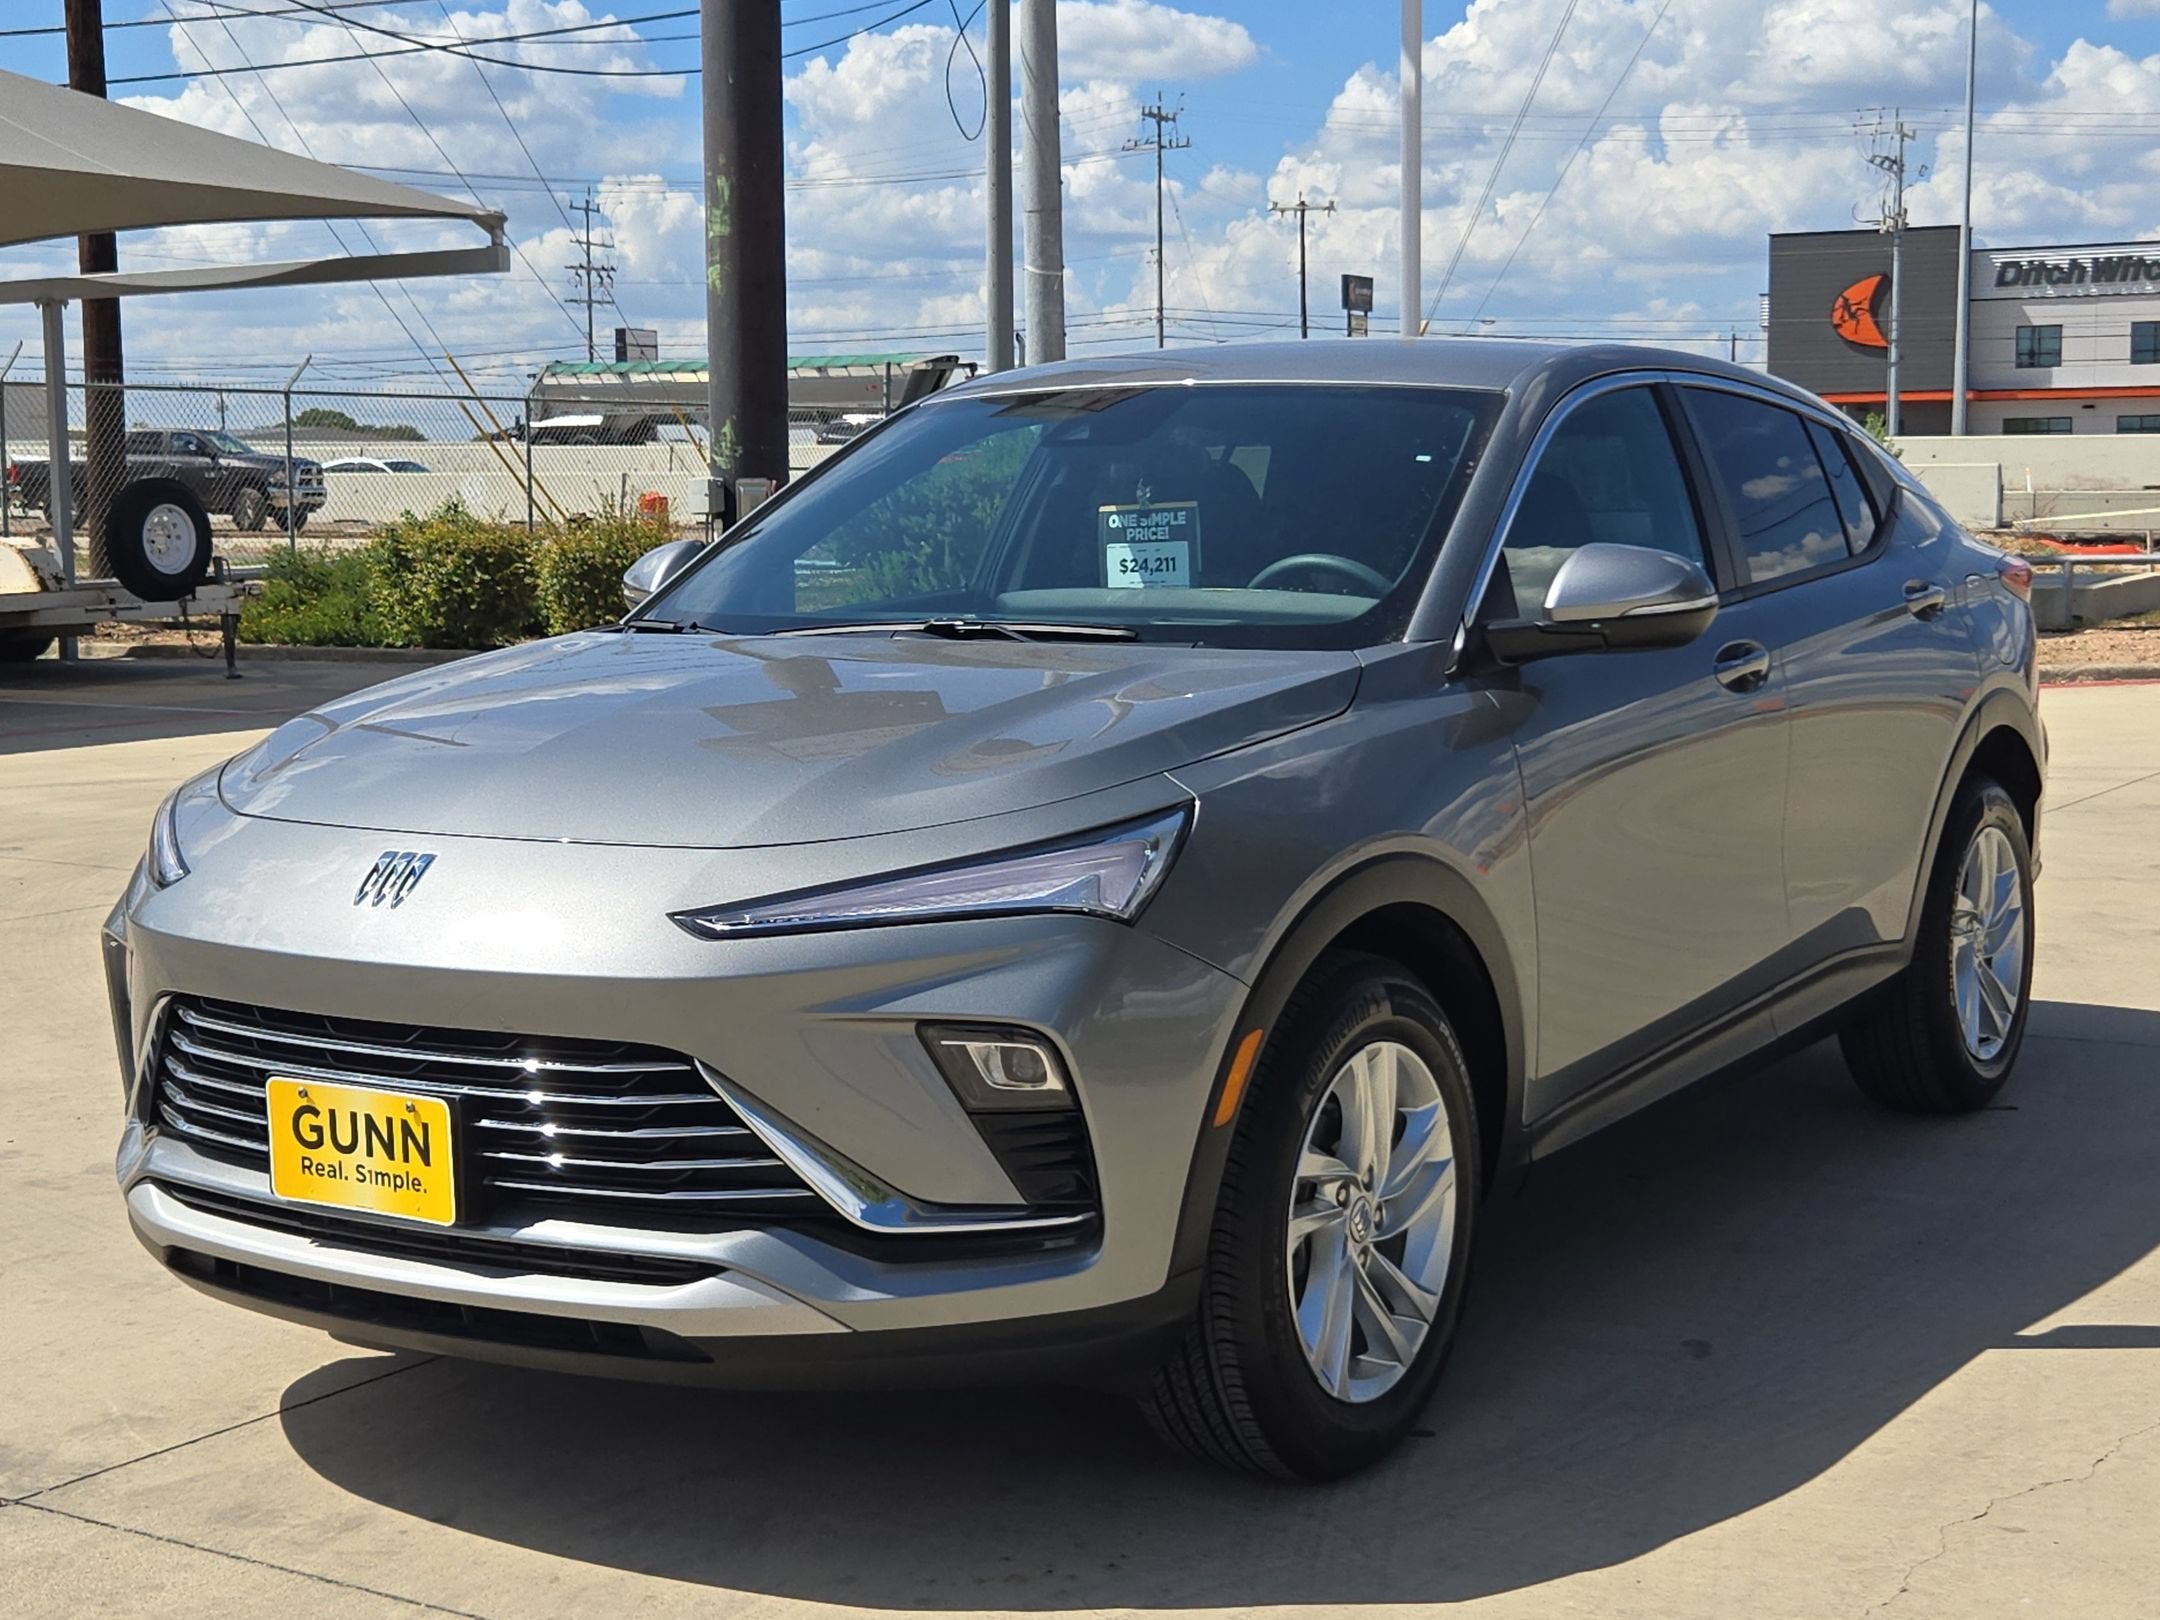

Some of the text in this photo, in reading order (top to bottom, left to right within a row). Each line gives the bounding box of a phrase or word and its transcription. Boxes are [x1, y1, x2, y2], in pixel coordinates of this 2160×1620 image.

[1996, 260, 2087, 287] Ditch
[1109, 512, 1186, 528] ONE SIMPLE
[1126, 526, 1169, 541] PRICE!
[1120, 556, 1176, 577] $24,211
[291, 1104, 431, 1167] GUNN
[301, 1155, 349, 1181] Real.
